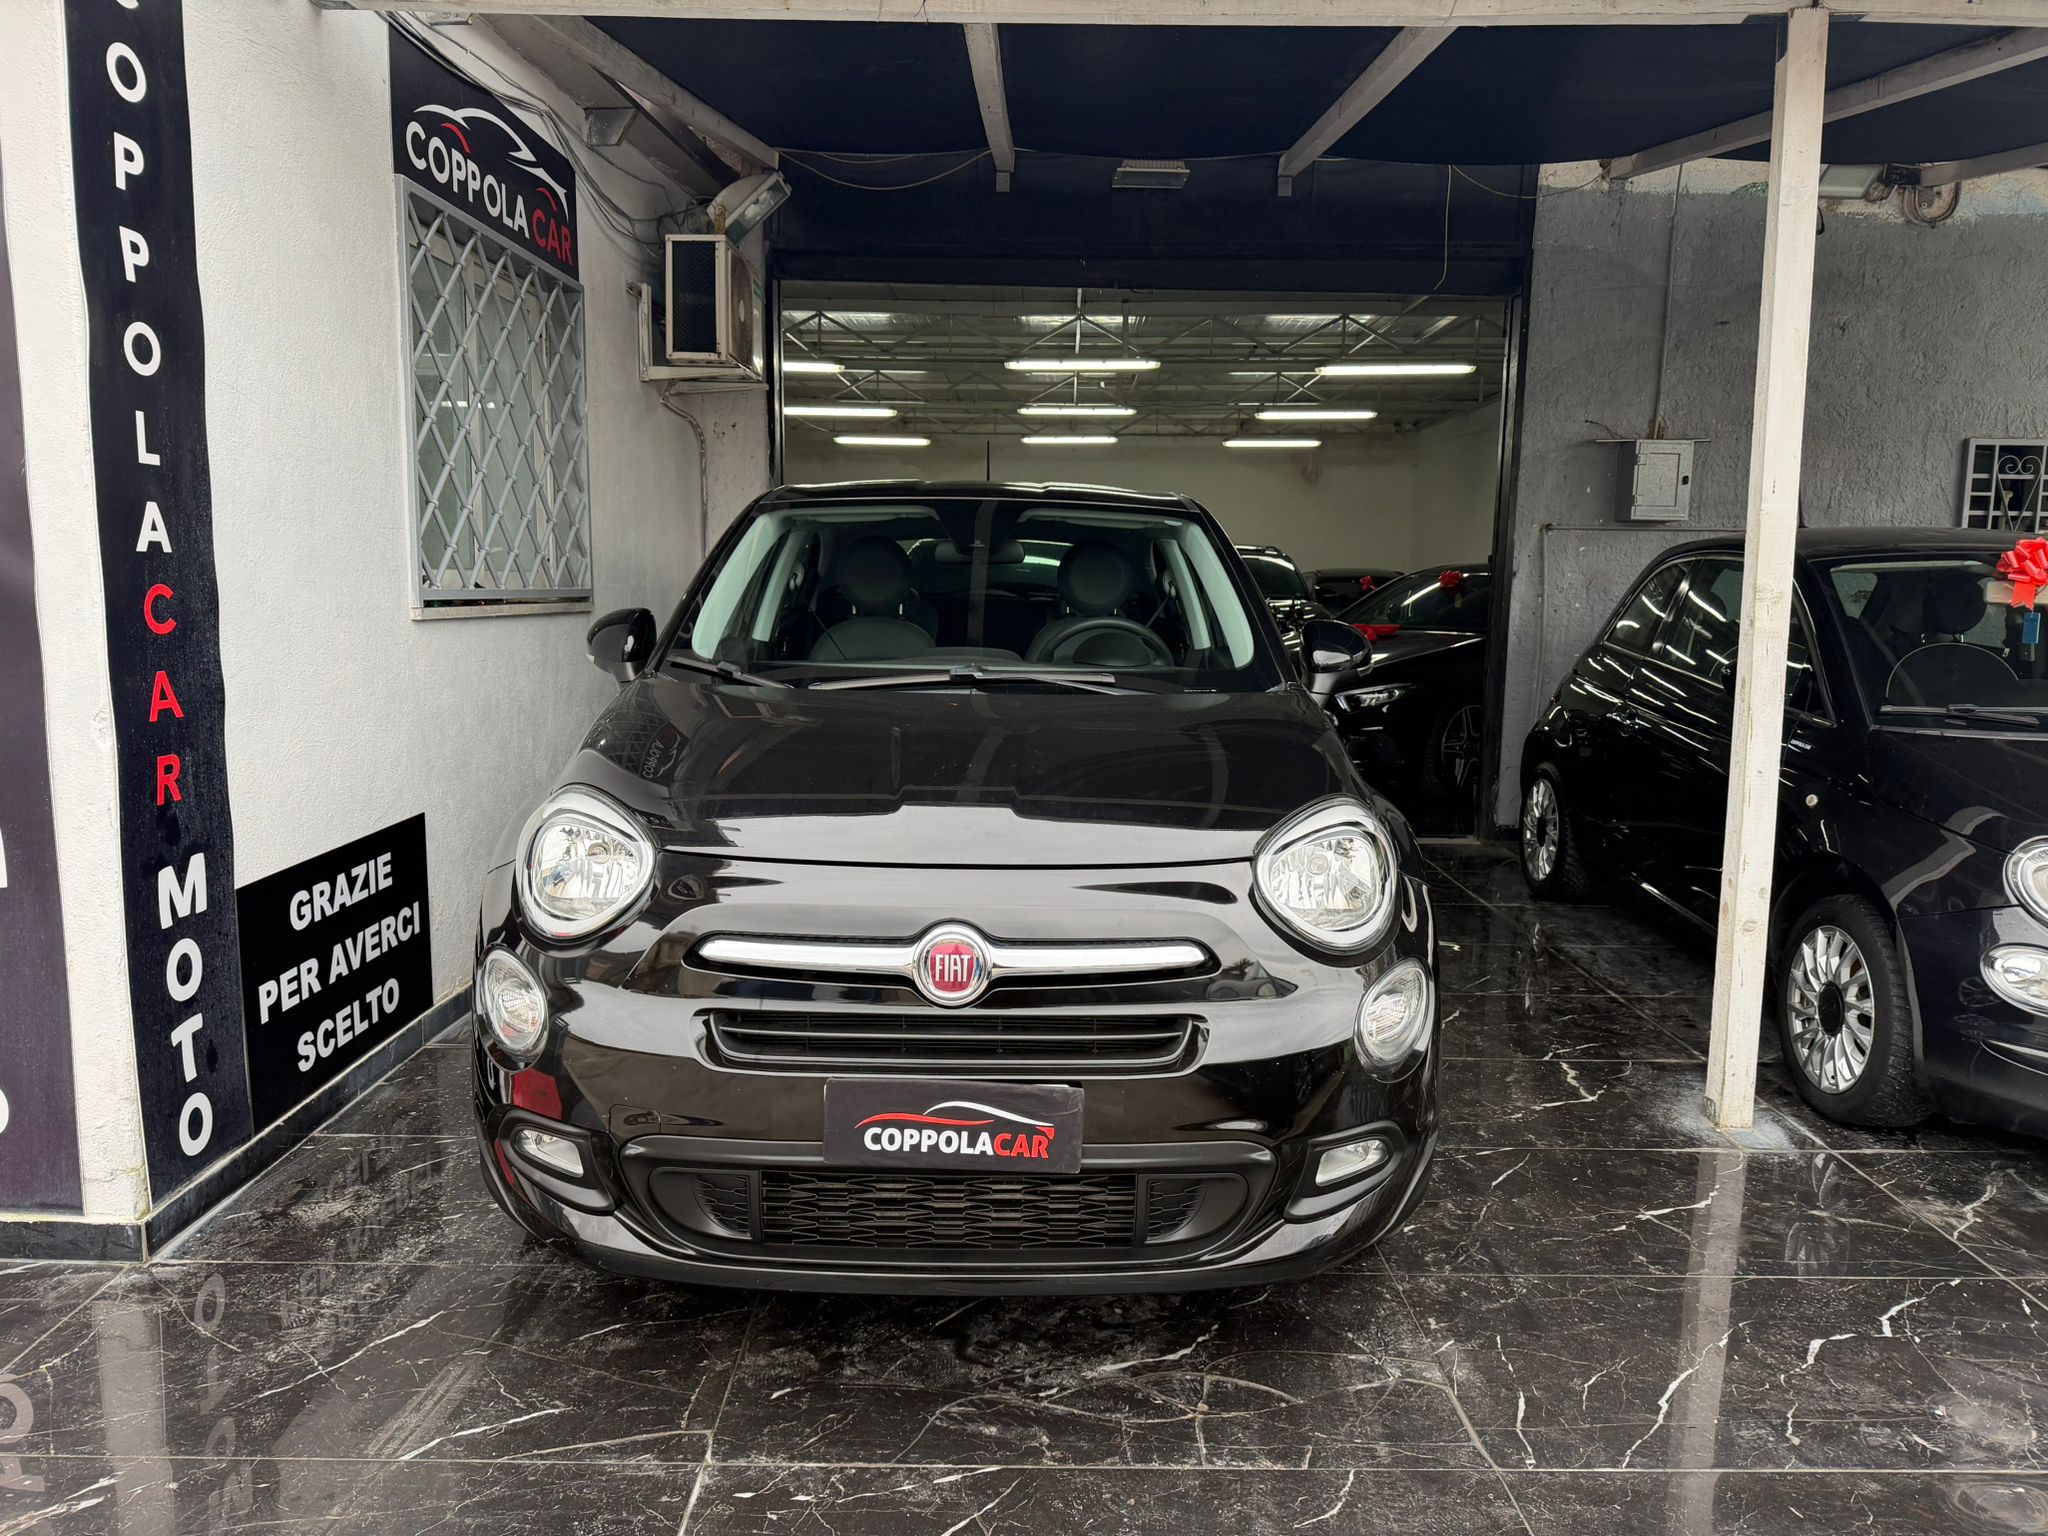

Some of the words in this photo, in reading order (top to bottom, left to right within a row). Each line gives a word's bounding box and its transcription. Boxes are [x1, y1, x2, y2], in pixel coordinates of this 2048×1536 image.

[290, 853, 393, 931] GRAZIE
[157, 852, 213, 1157] MOTO
[259, 957, 320, 1024] PER
[329, 901, 420, 984] AVERCI
[935, 953, 971, 983] FIAT
[298, 979, 400, 1072] SCELTO
